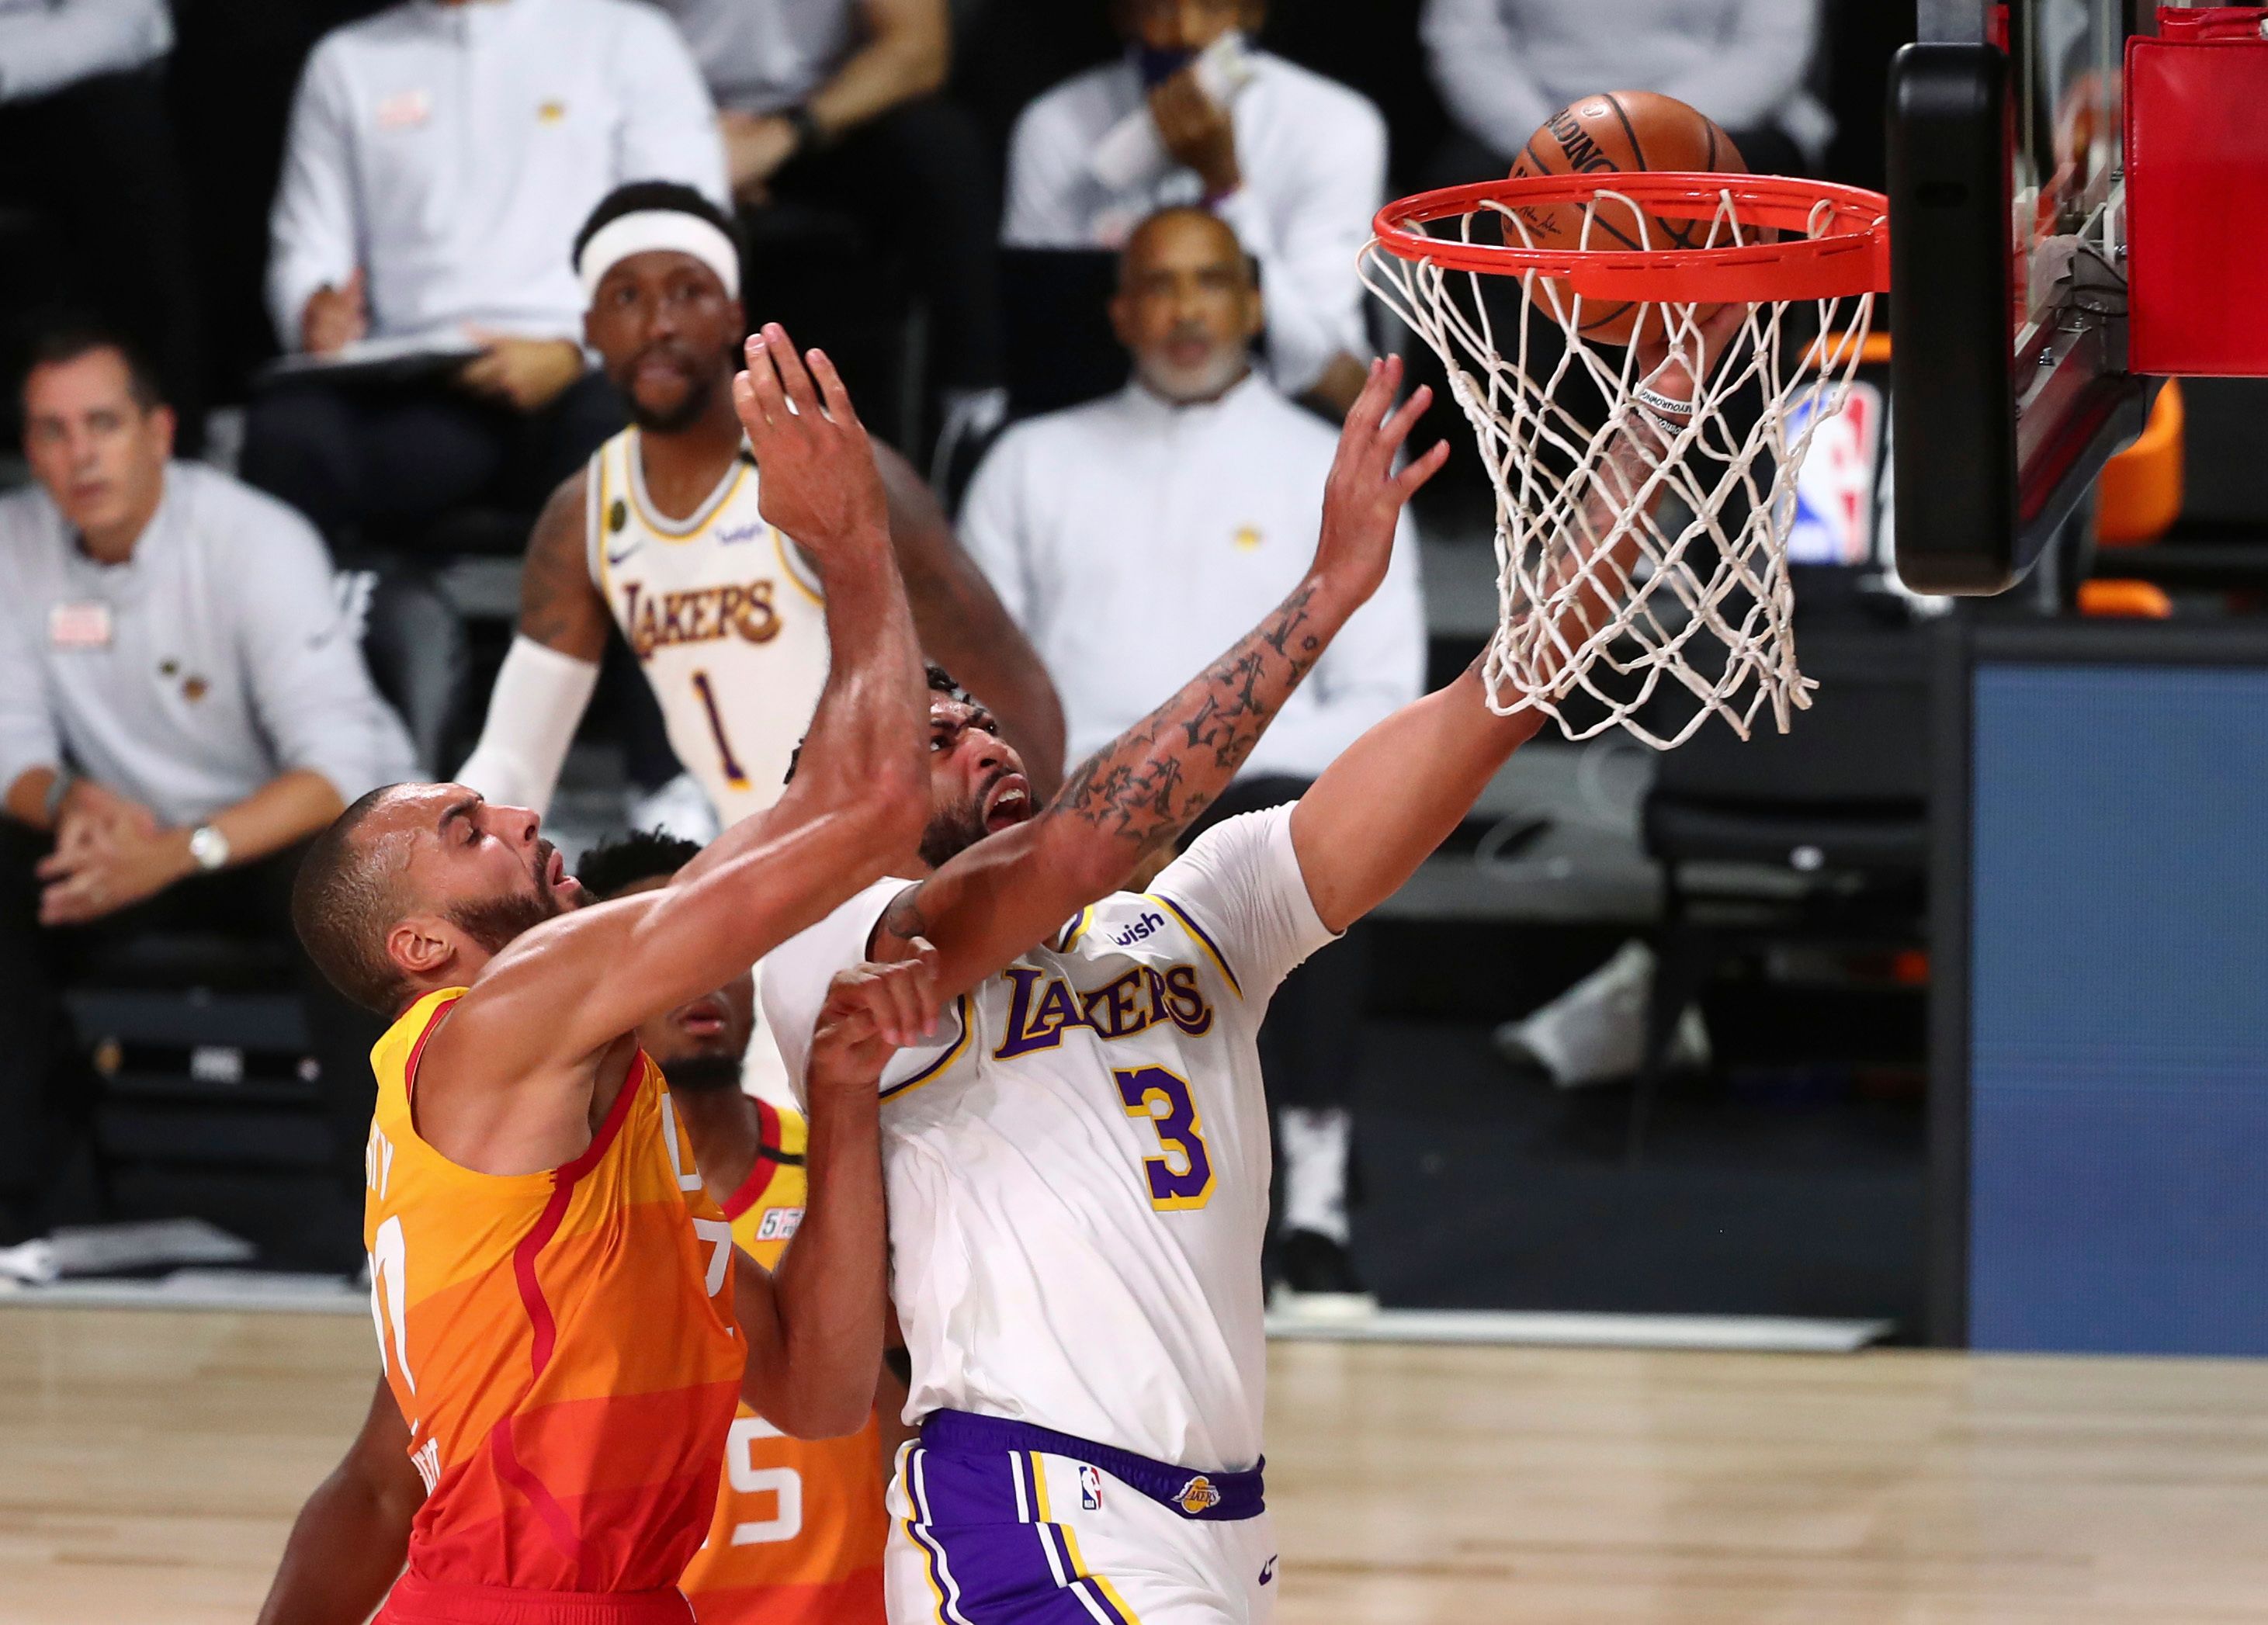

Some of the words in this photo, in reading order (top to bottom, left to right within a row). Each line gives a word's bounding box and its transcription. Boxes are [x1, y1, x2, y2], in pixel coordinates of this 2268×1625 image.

[622, 579, 781, 661] LAKERS
[690, 669, 752, 792] 1
[1106, 911, 1165, 947] wish
[992, 963, 1215, 1062] LAKERS
[1110, 1062, 1218, 1212] 3
[701, 1415, 803, 1549] 5
